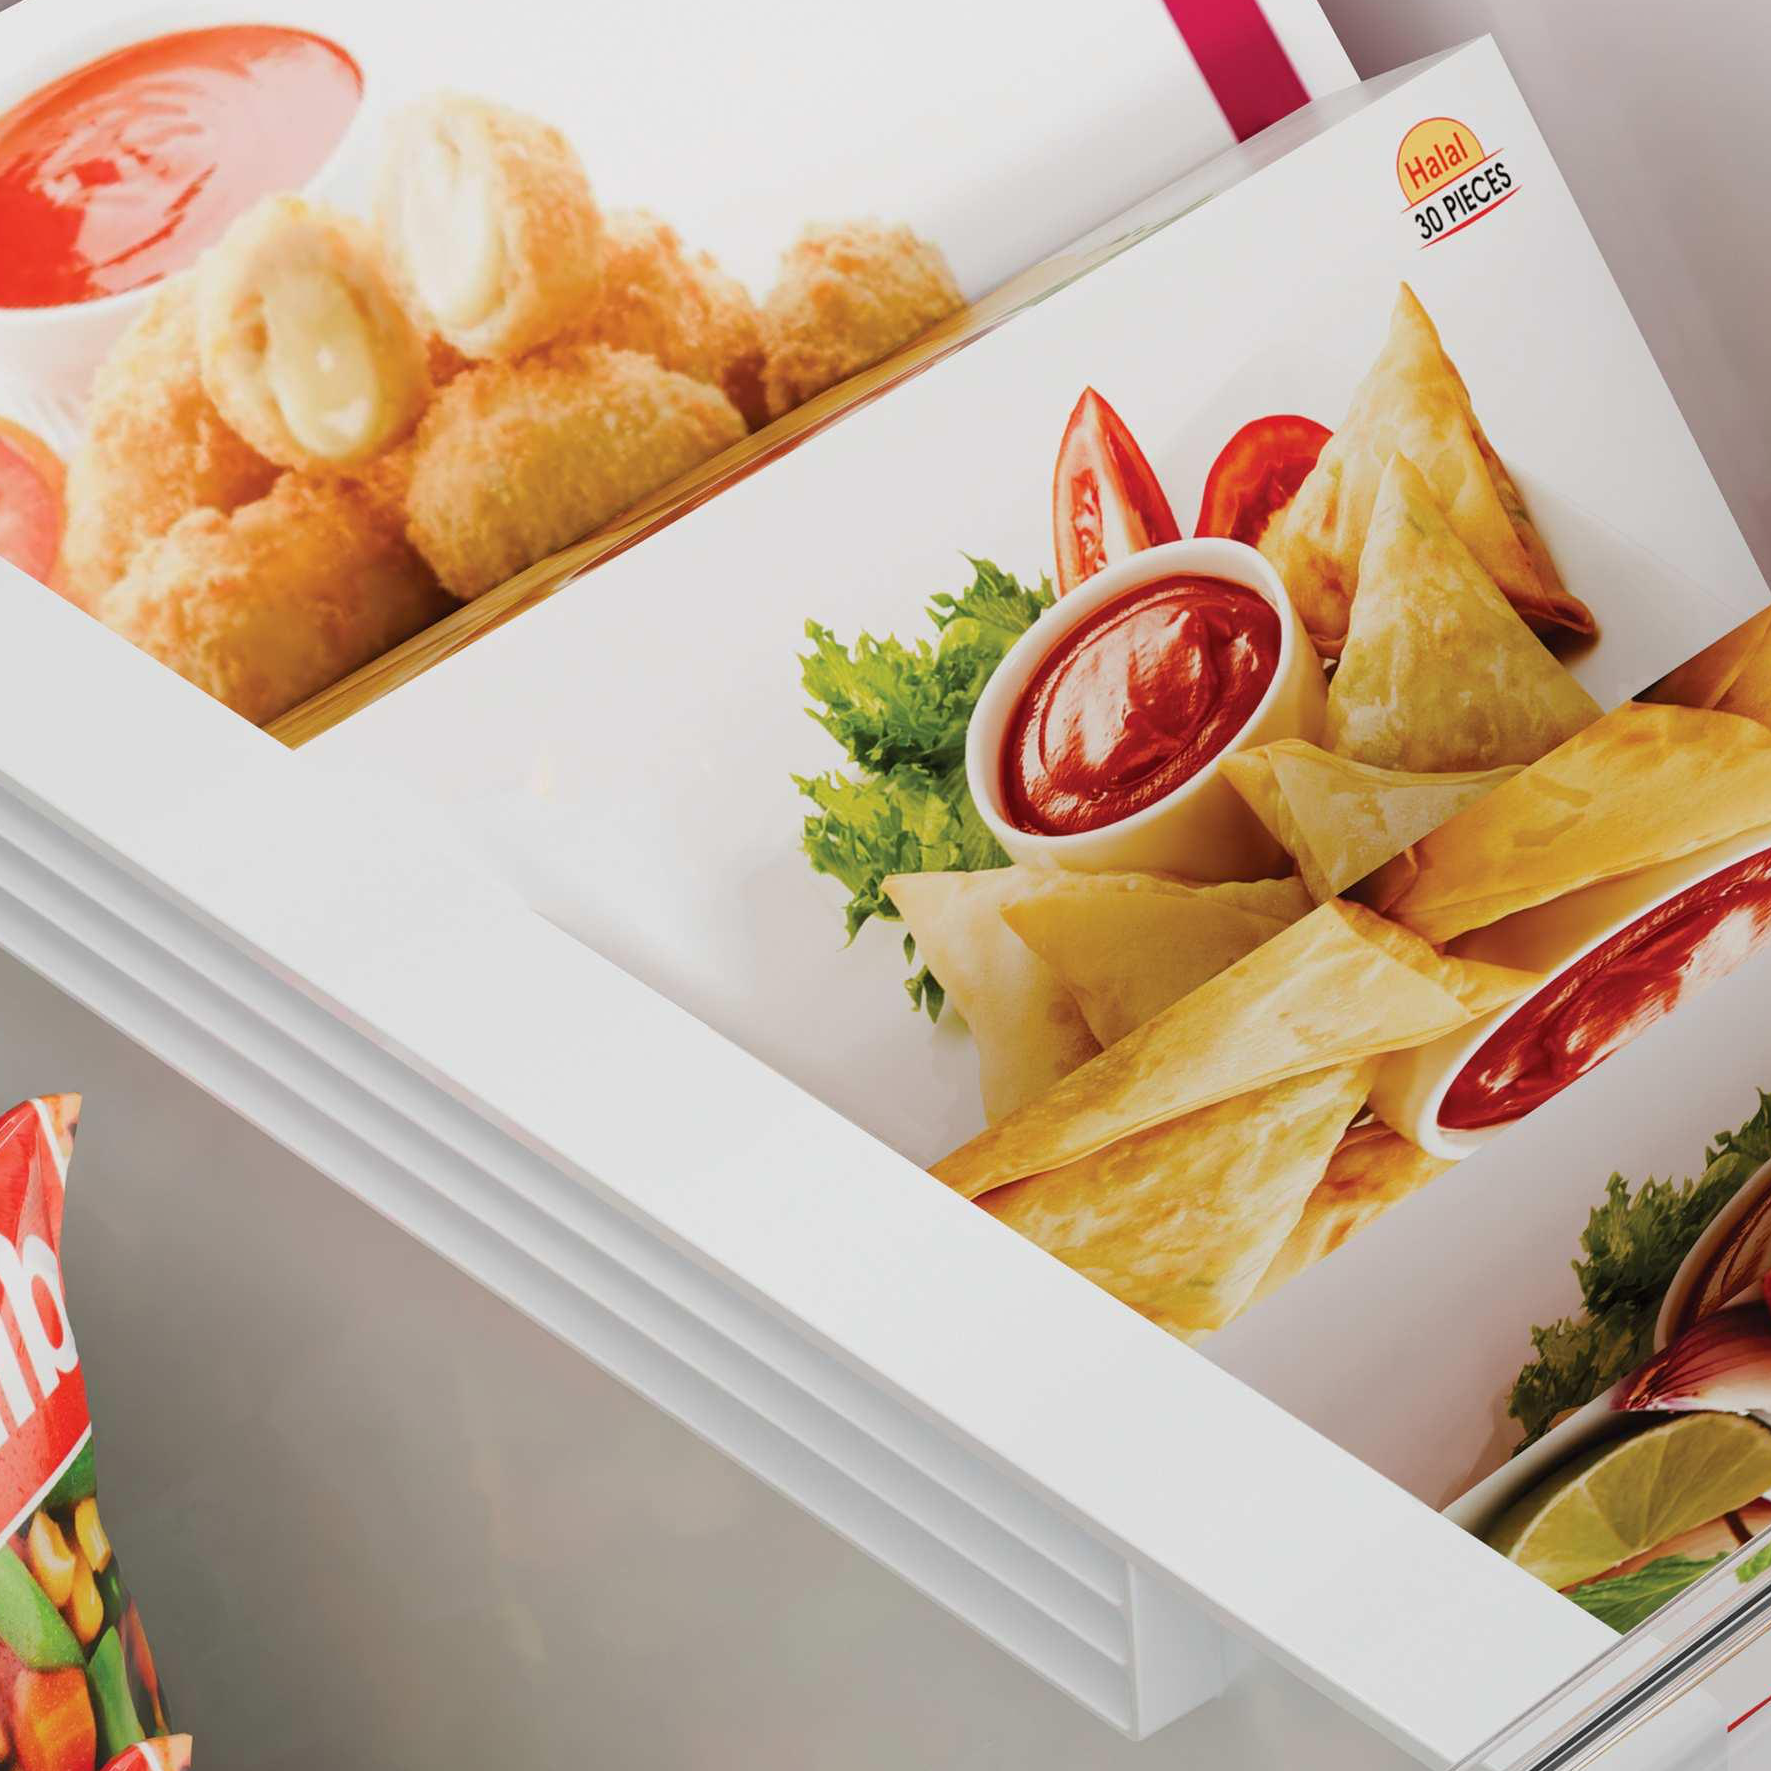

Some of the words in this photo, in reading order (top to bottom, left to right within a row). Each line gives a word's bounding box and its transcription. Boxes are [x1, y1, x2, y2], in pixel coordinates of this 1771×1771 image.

[1404, 131, 1469, 190] Halal
[1415, 206, 1444, 240] 30
[1442, 162, 1512, 222] PIECES
